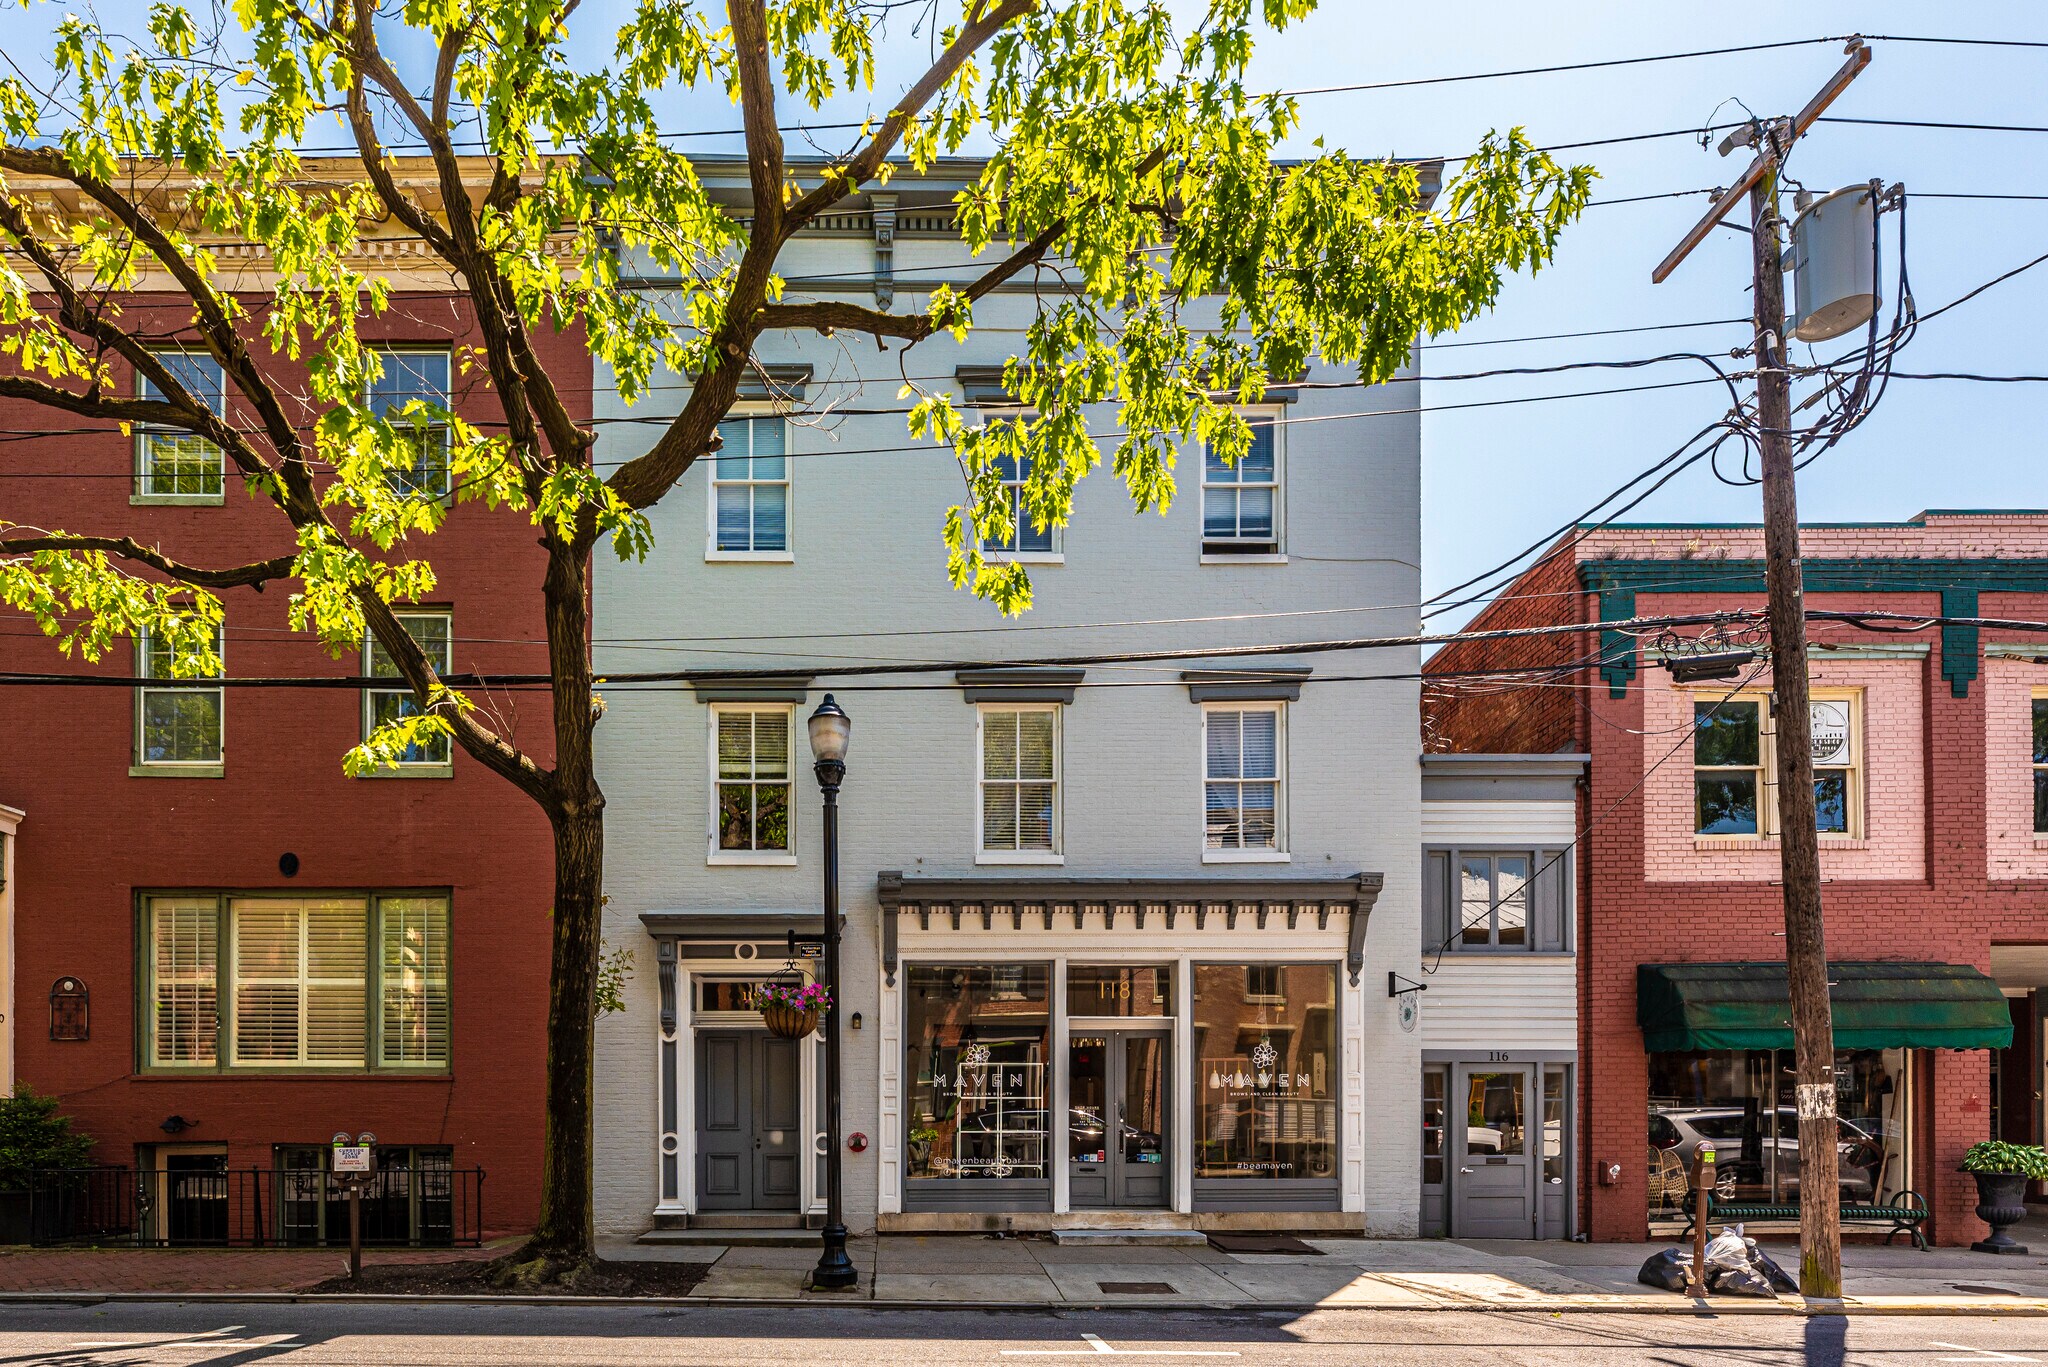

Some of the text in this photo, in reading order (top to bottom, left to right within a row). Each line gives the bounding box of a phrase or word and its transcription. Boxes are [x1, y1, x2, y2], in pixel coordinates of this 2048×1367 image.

[1101, 981, 1130, 999] 118
[1489, 1051, 1509, 1062] 116
[933, 1073, 1023, 1088] MAVEN
[1220, 1073, 1310, 1088] MAVEN
[1237, 1161, 1293, 1170] #beamaven
